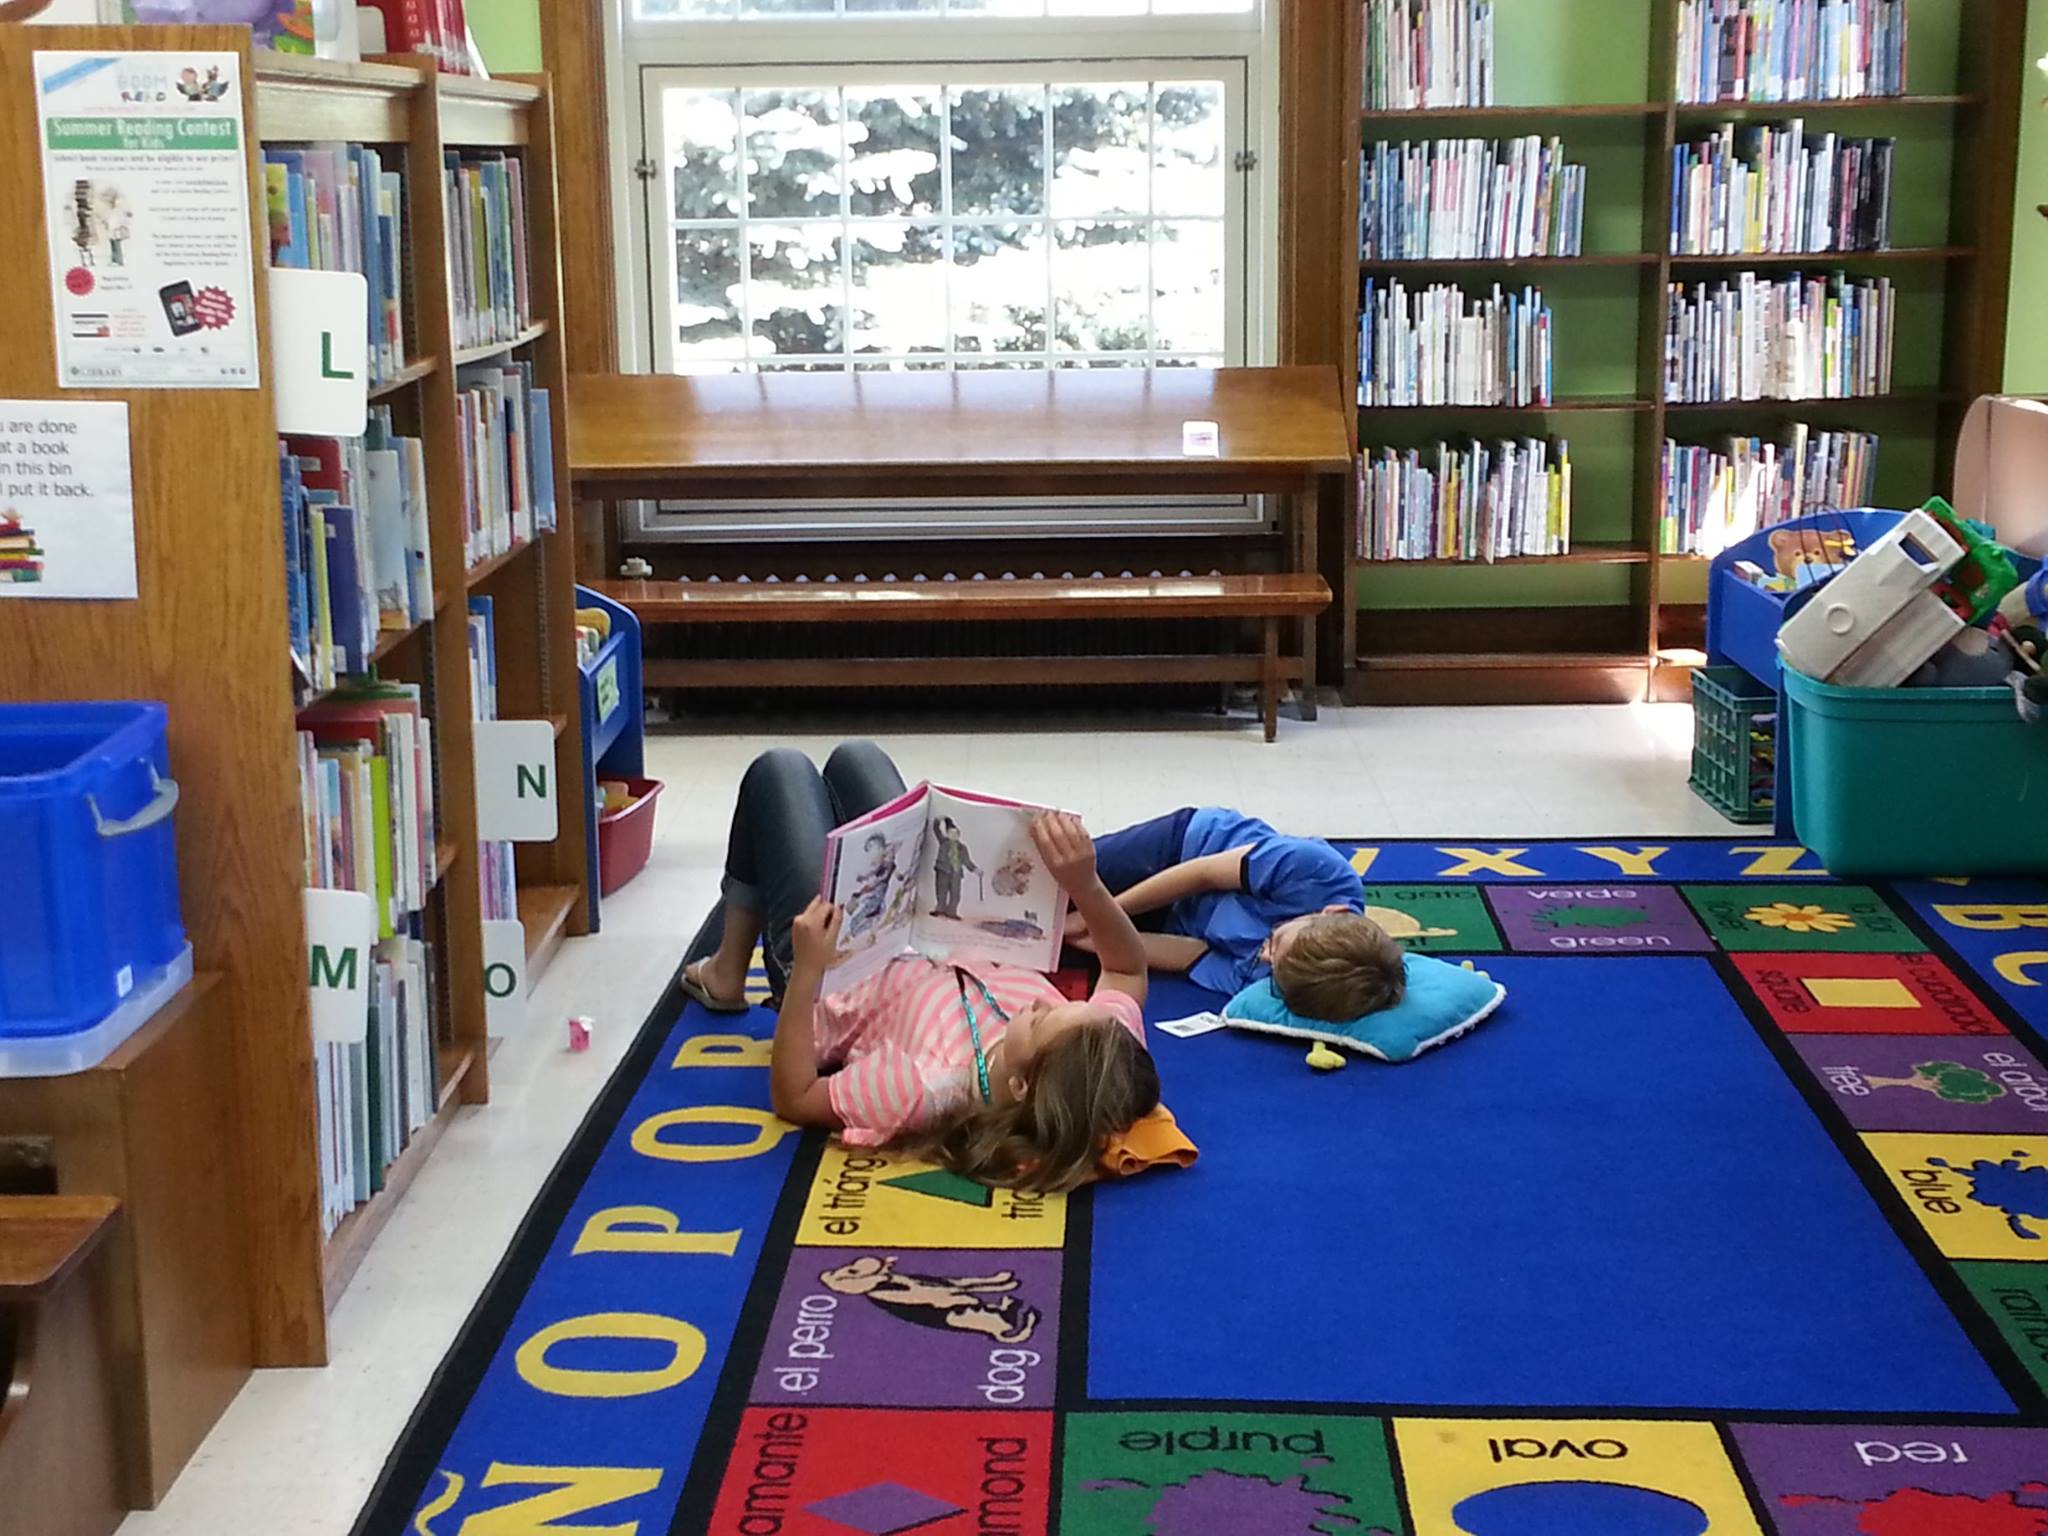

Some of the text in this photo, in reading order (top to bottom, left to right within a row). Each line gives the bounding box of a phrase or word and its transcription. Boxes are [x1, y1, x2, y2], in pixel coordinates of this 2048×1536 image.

[54, 119, 231, 140] Summer Reading Contest
[321, 331, 354, 380] L
[9, 421, 34, 433] are
[39, 420, 78, 434] done
[17, 442, 27, 454] a
[32, 441, 70, 455] book
[16, 462, 44, 475] this
[49, 462, 73, 475] bin
[9, 484, 33, 498] put
[39, 483, 48, 496] it
[54, 483, 95, 497] back.
[517, 764, 547, 798] N
[1434, 846, 1831, 876] X Y Z
[1527, 888, 1638, 900] verde
[1930, 904, 2048, 930] B
[1549, 935, 1672, 949] green
[309, 944, 357, 990] M
[484, 962, 517, 998] O
[1982, 1052, 2028, 1067] el
[1821, 1065, 1870, 1097] tree
[818, 1154, 887, 1235] el triáng
[1900, 1169, 1962, 1215] blue
[415, 1034, 803, 1536] Ñ O P Q R
[773, 1293, 838, 1392] el perro
[976, 1348, 1041, 1403] dog
[1118, 1427, 1325, 1456] purple
[1488, 1438, 1629, 1463] oval
[1853, 1440, 1969, 1467] red
[977, 1436, 1027, 1536] mond
